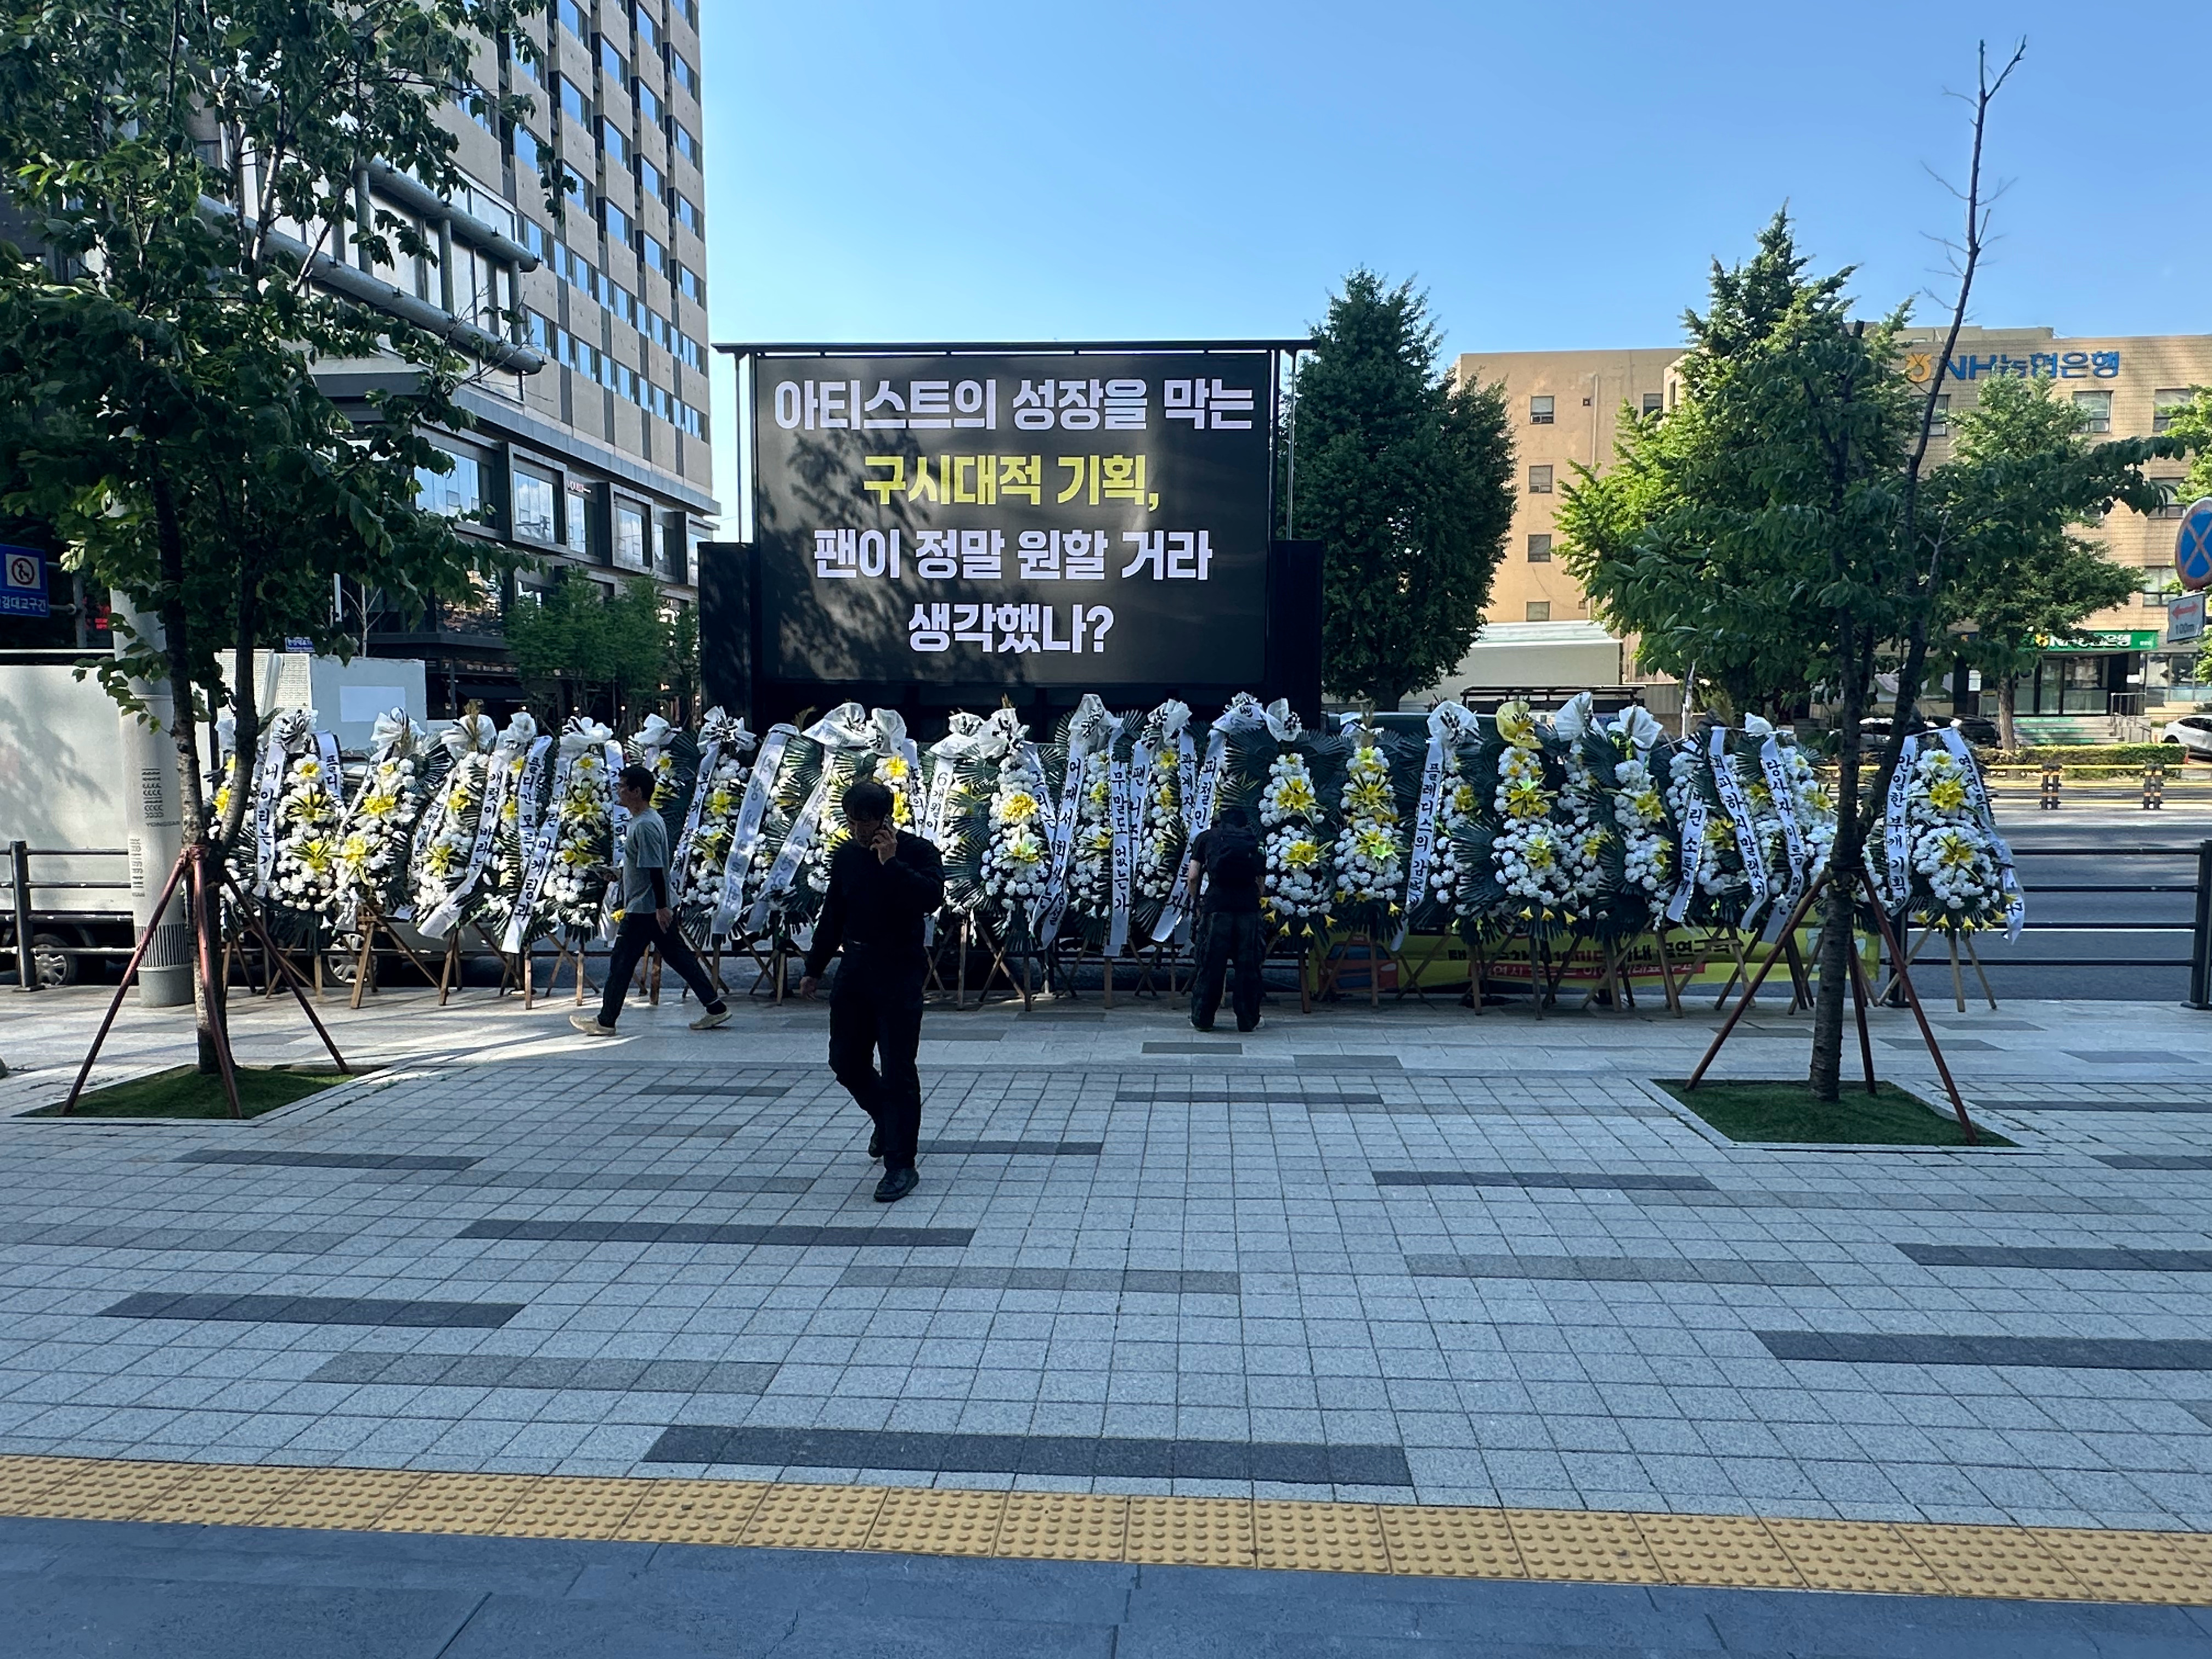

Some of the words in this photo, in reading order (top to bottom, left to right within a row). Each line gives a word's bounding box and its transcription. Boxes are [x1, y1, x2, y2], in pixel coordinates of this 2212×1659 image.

[775, 379, 996, 430] 아티스트의
[1012, 379, 1148, 430] 성장을
[1163, 379, 1254, 430] 막는
[862, 455, 1041, 506] 구시대적
[1057, 455, 1159, 512] 기획,
[813, 528, 900, 580] 팬이
[915, 528, 1002, 580] 정말
[1017, 528, 1108, 580] 원할
[1121, 528, 1212, 580] 거라
[0, 595, 47, 612] 강대교구간
[908, 603, 1114, 653] 생각했나?
[2176, 622, 2195, 635] 100m
[1889, 753, 1914, 808] 안일한
[1415, 762, 1441, 852] 플레디스의
[1114, 845, 1130, 913] 없는가
